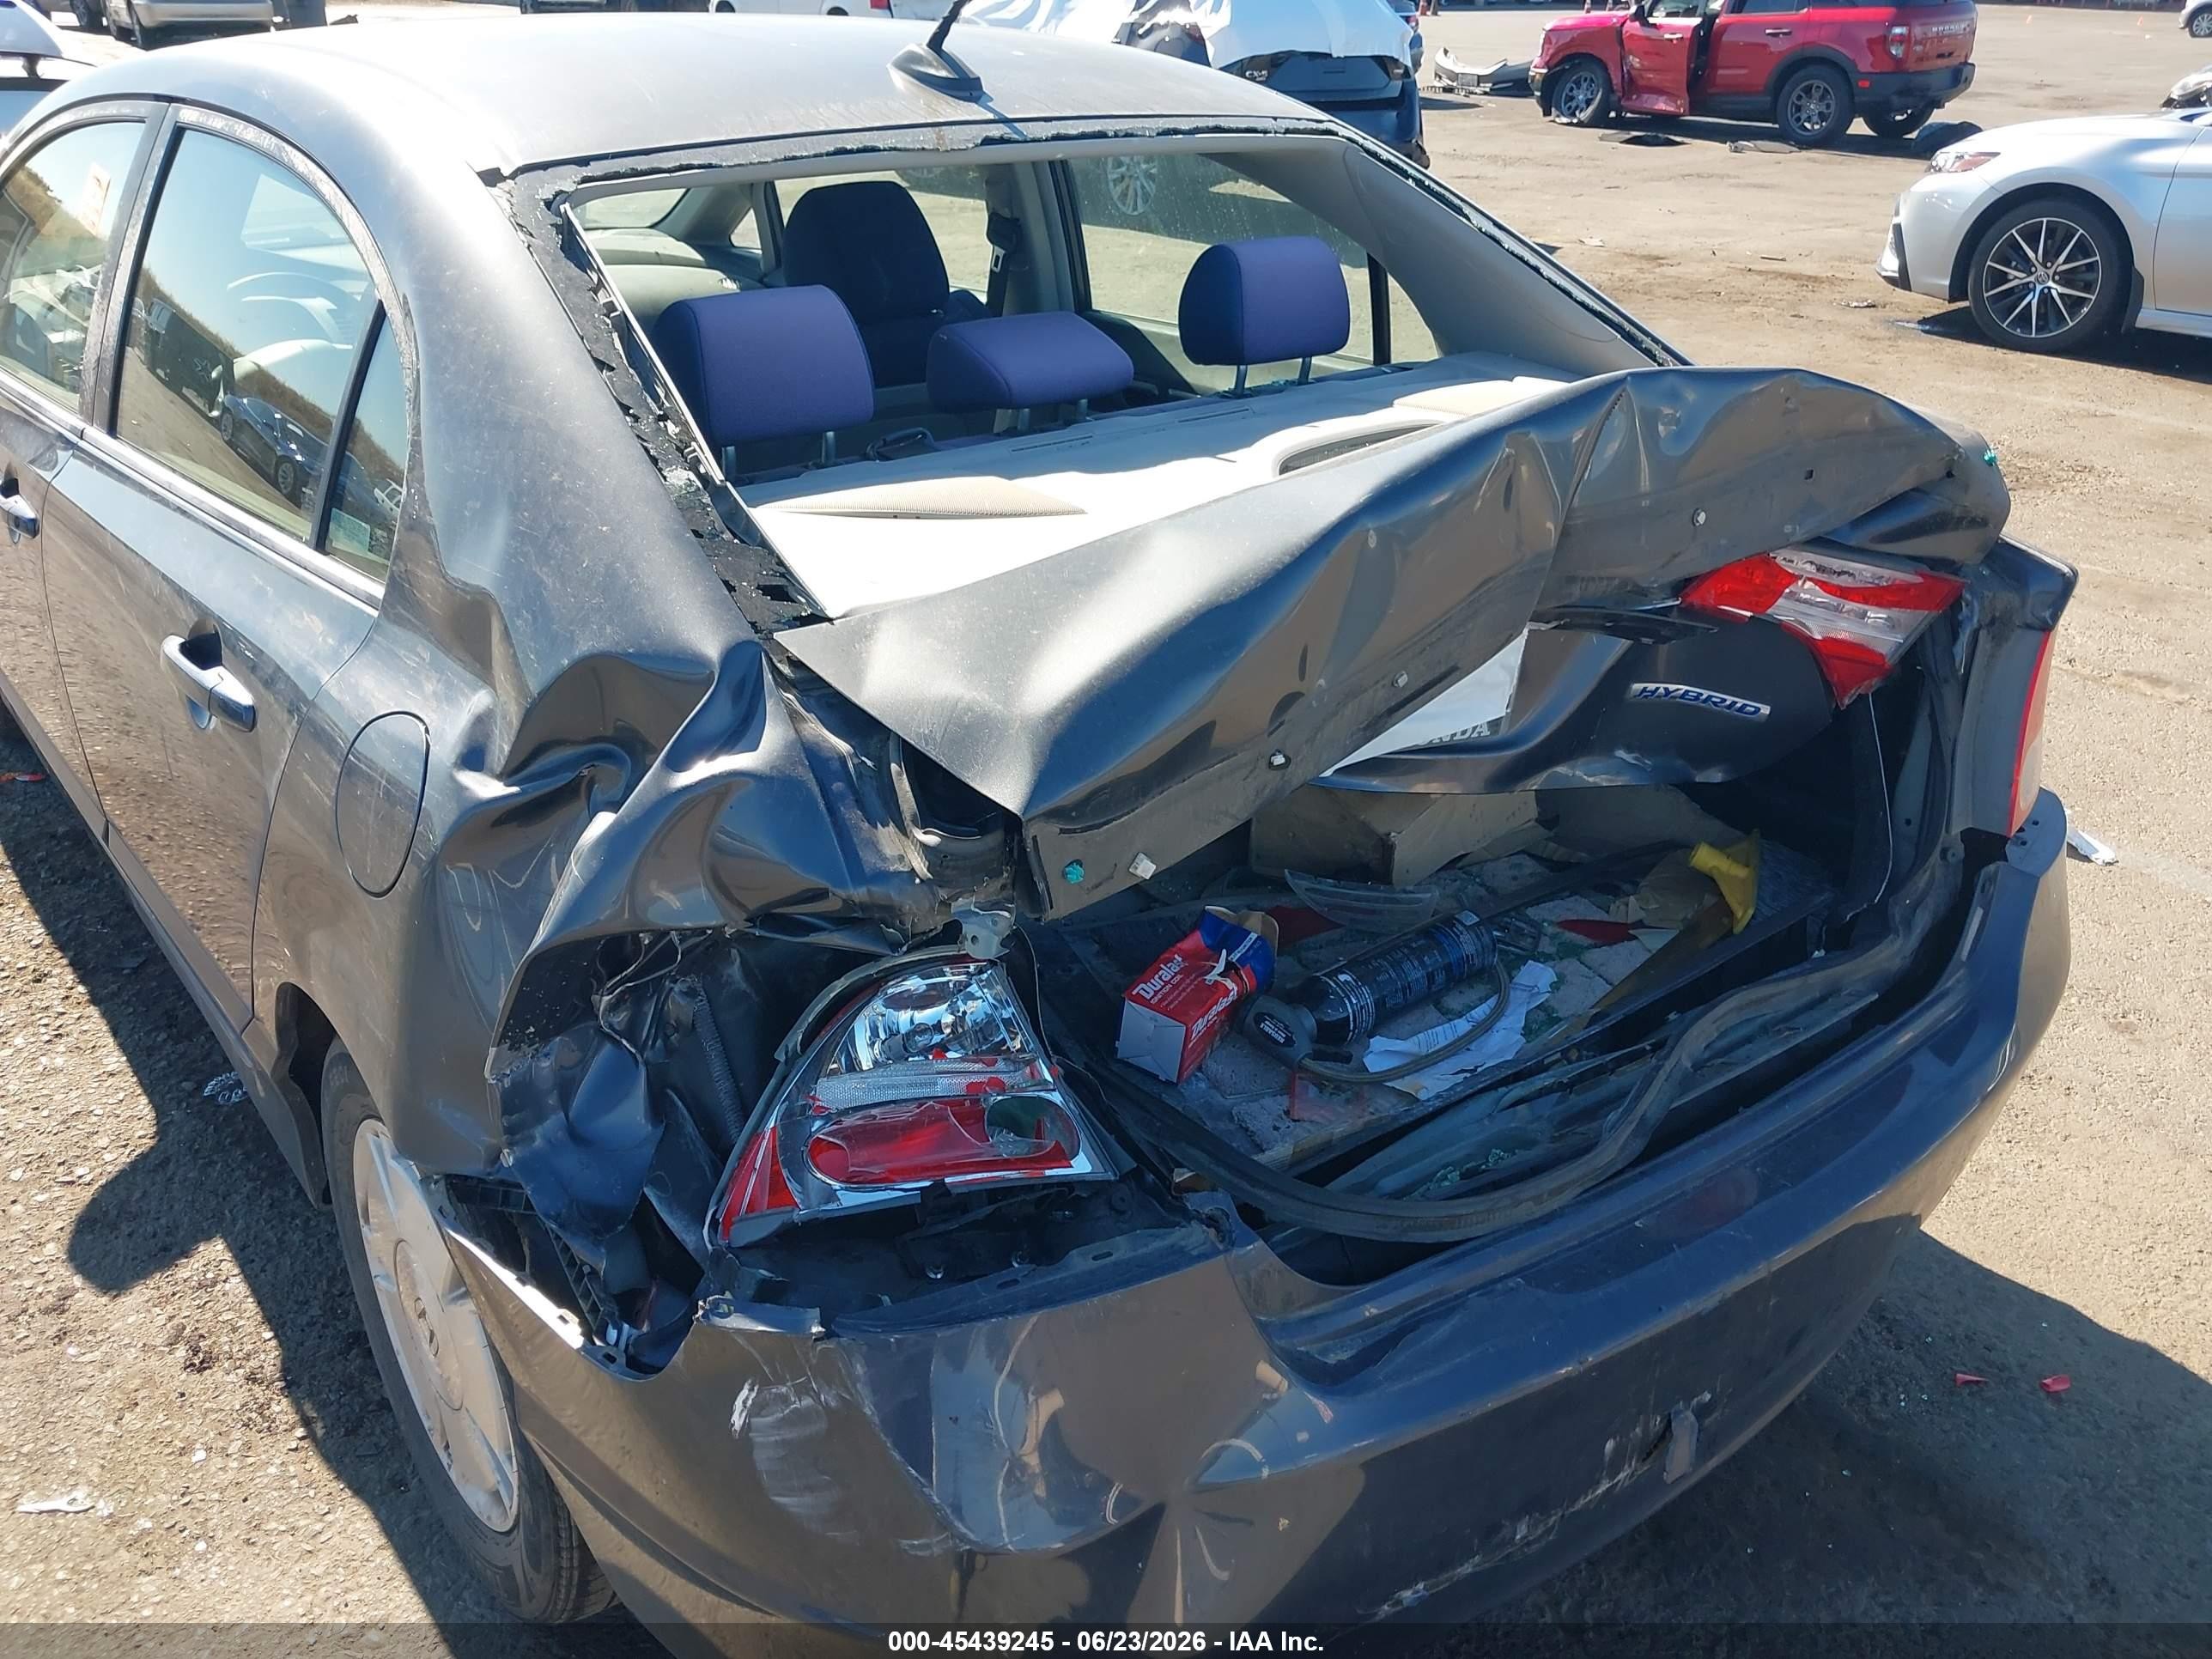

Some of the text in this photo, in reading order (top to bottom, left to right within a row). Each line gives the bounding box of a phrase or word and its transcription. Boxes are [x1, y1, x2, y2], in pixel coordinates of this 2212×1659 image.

[1245, 70, 1268, 78] CX-5
[1636, 686, 1761, 716] HYBRID
[1132, 953, 1185, 1000] Duralast
